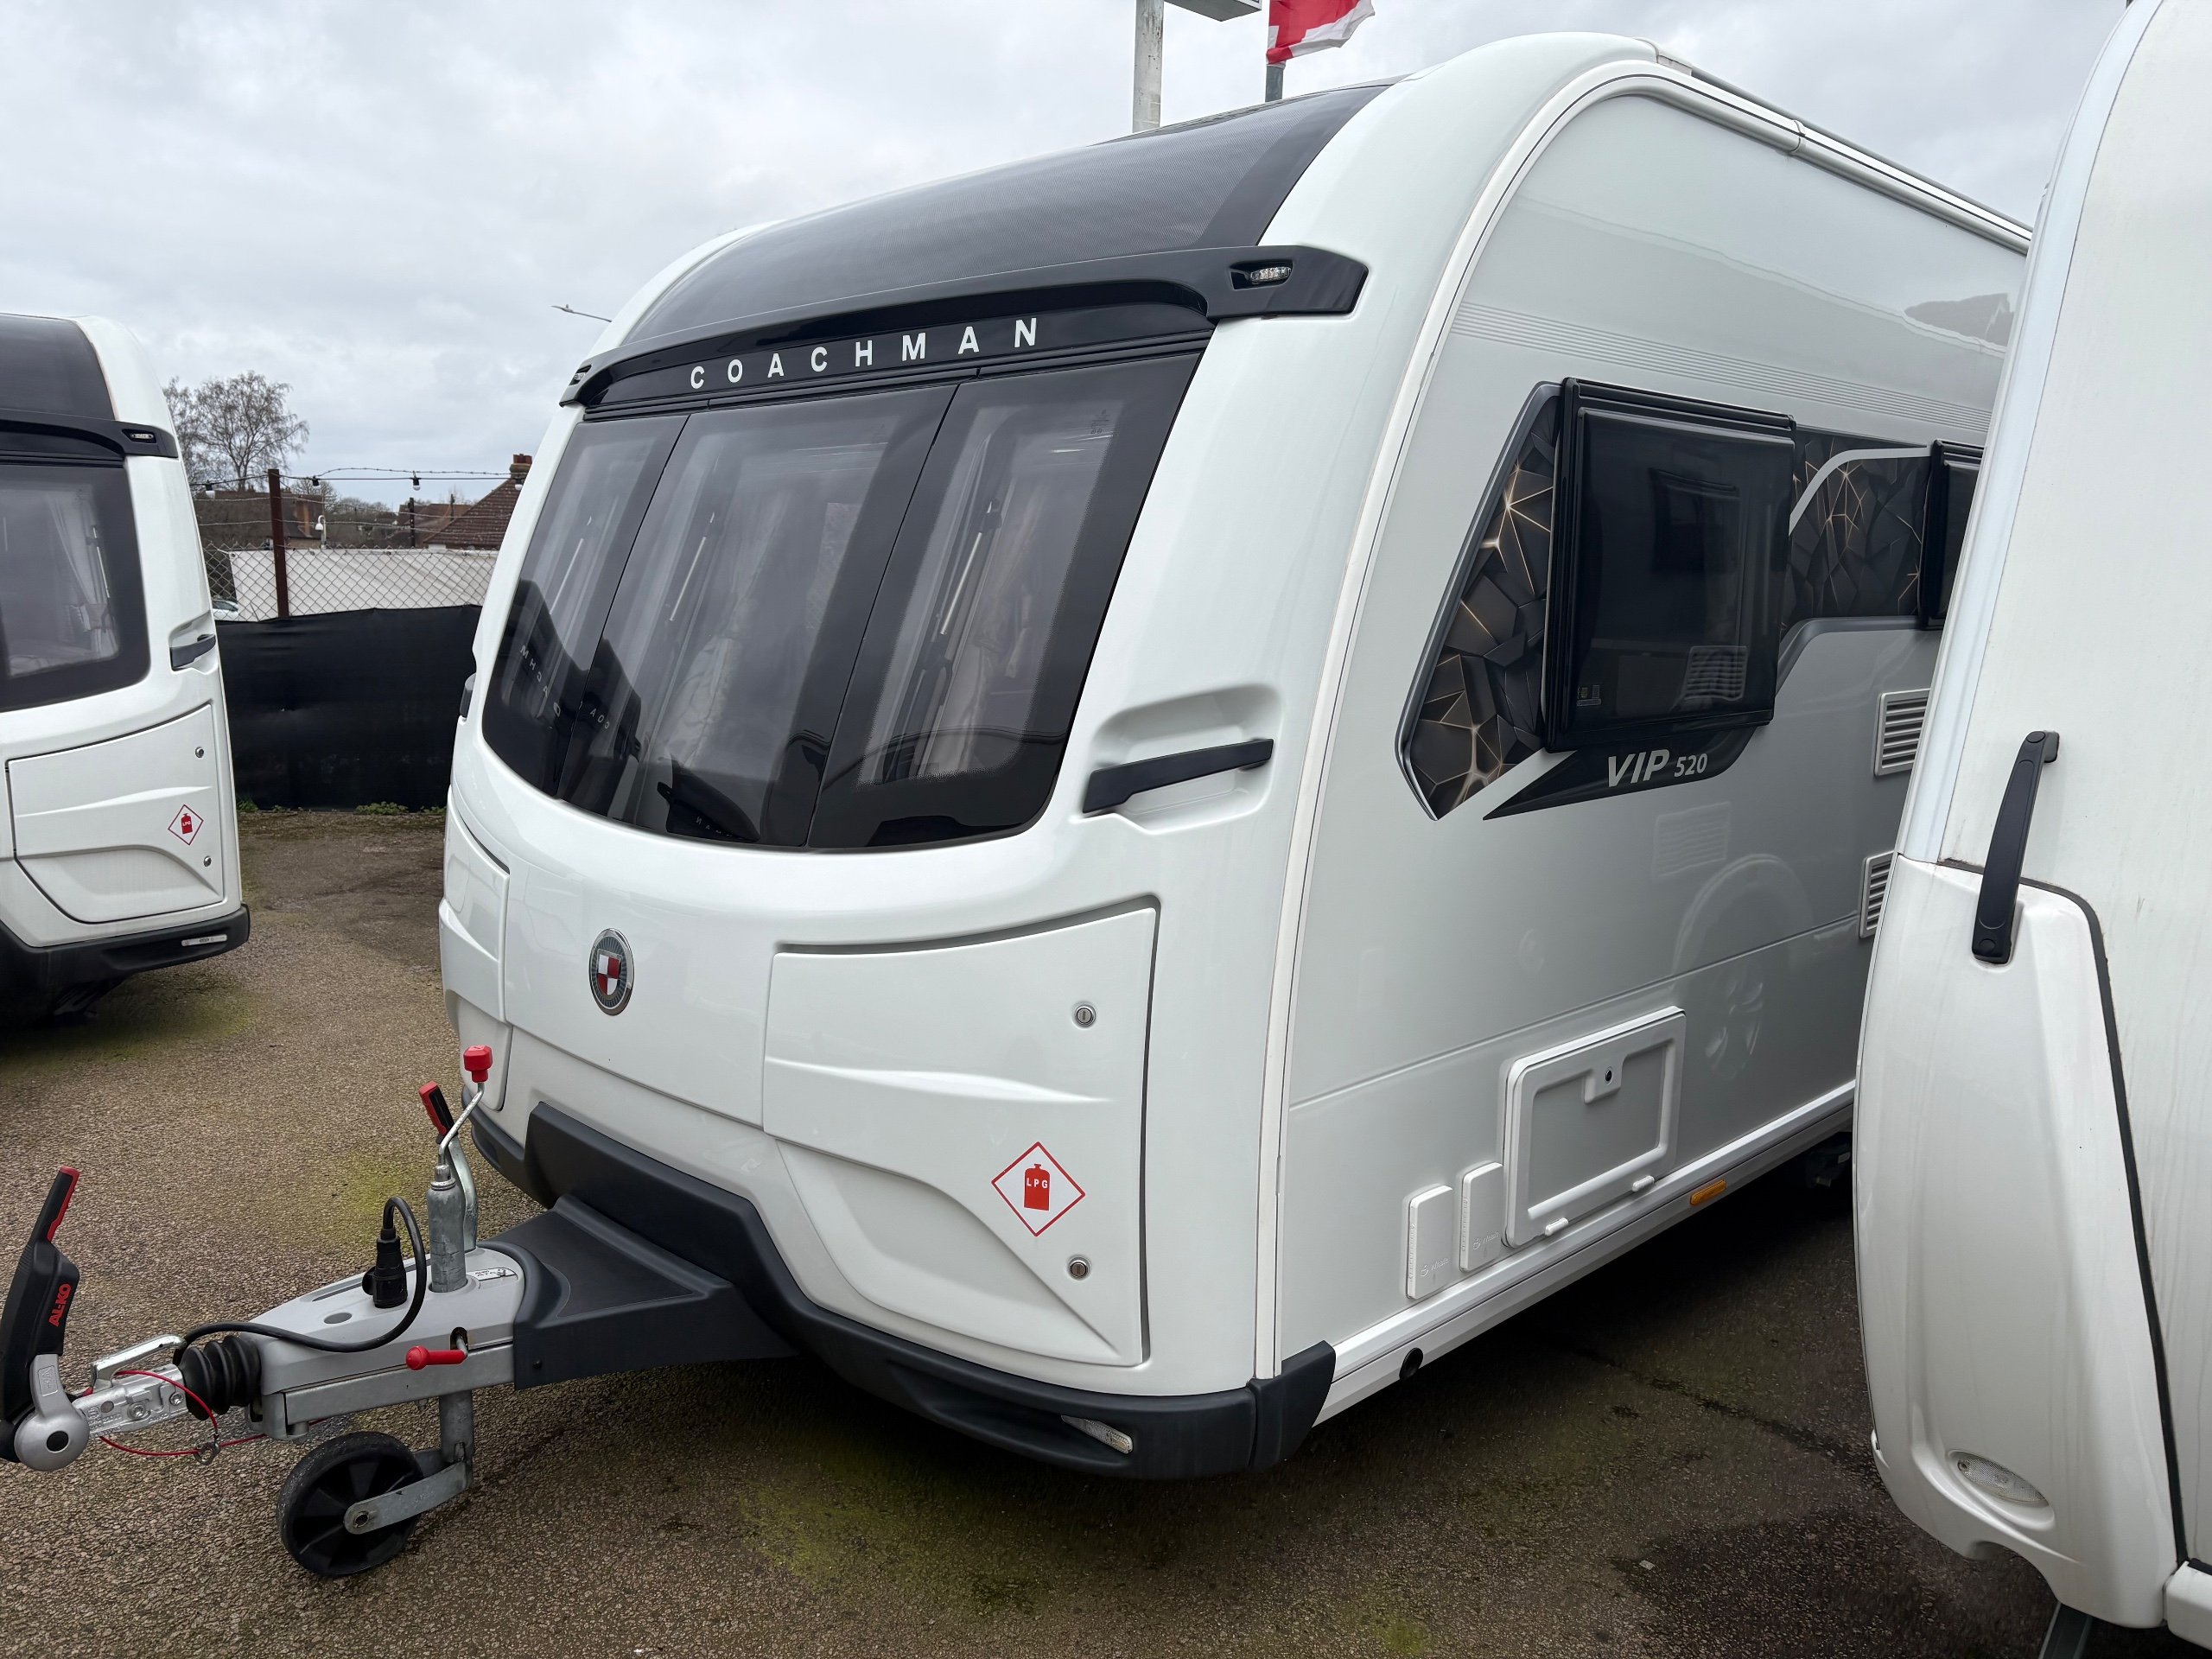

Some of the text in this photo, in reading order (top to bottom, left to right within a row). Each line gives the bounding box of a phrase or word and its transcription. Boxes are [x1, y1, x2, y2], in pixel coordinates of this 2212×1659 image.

[690, 317, 1037, 389] COACHMAN
[1608, 748, 1708, 788] VIP 520
[1027, 1177, 1048, 1189] LPG
[48, 1283, 72, 1327] AL-KO
